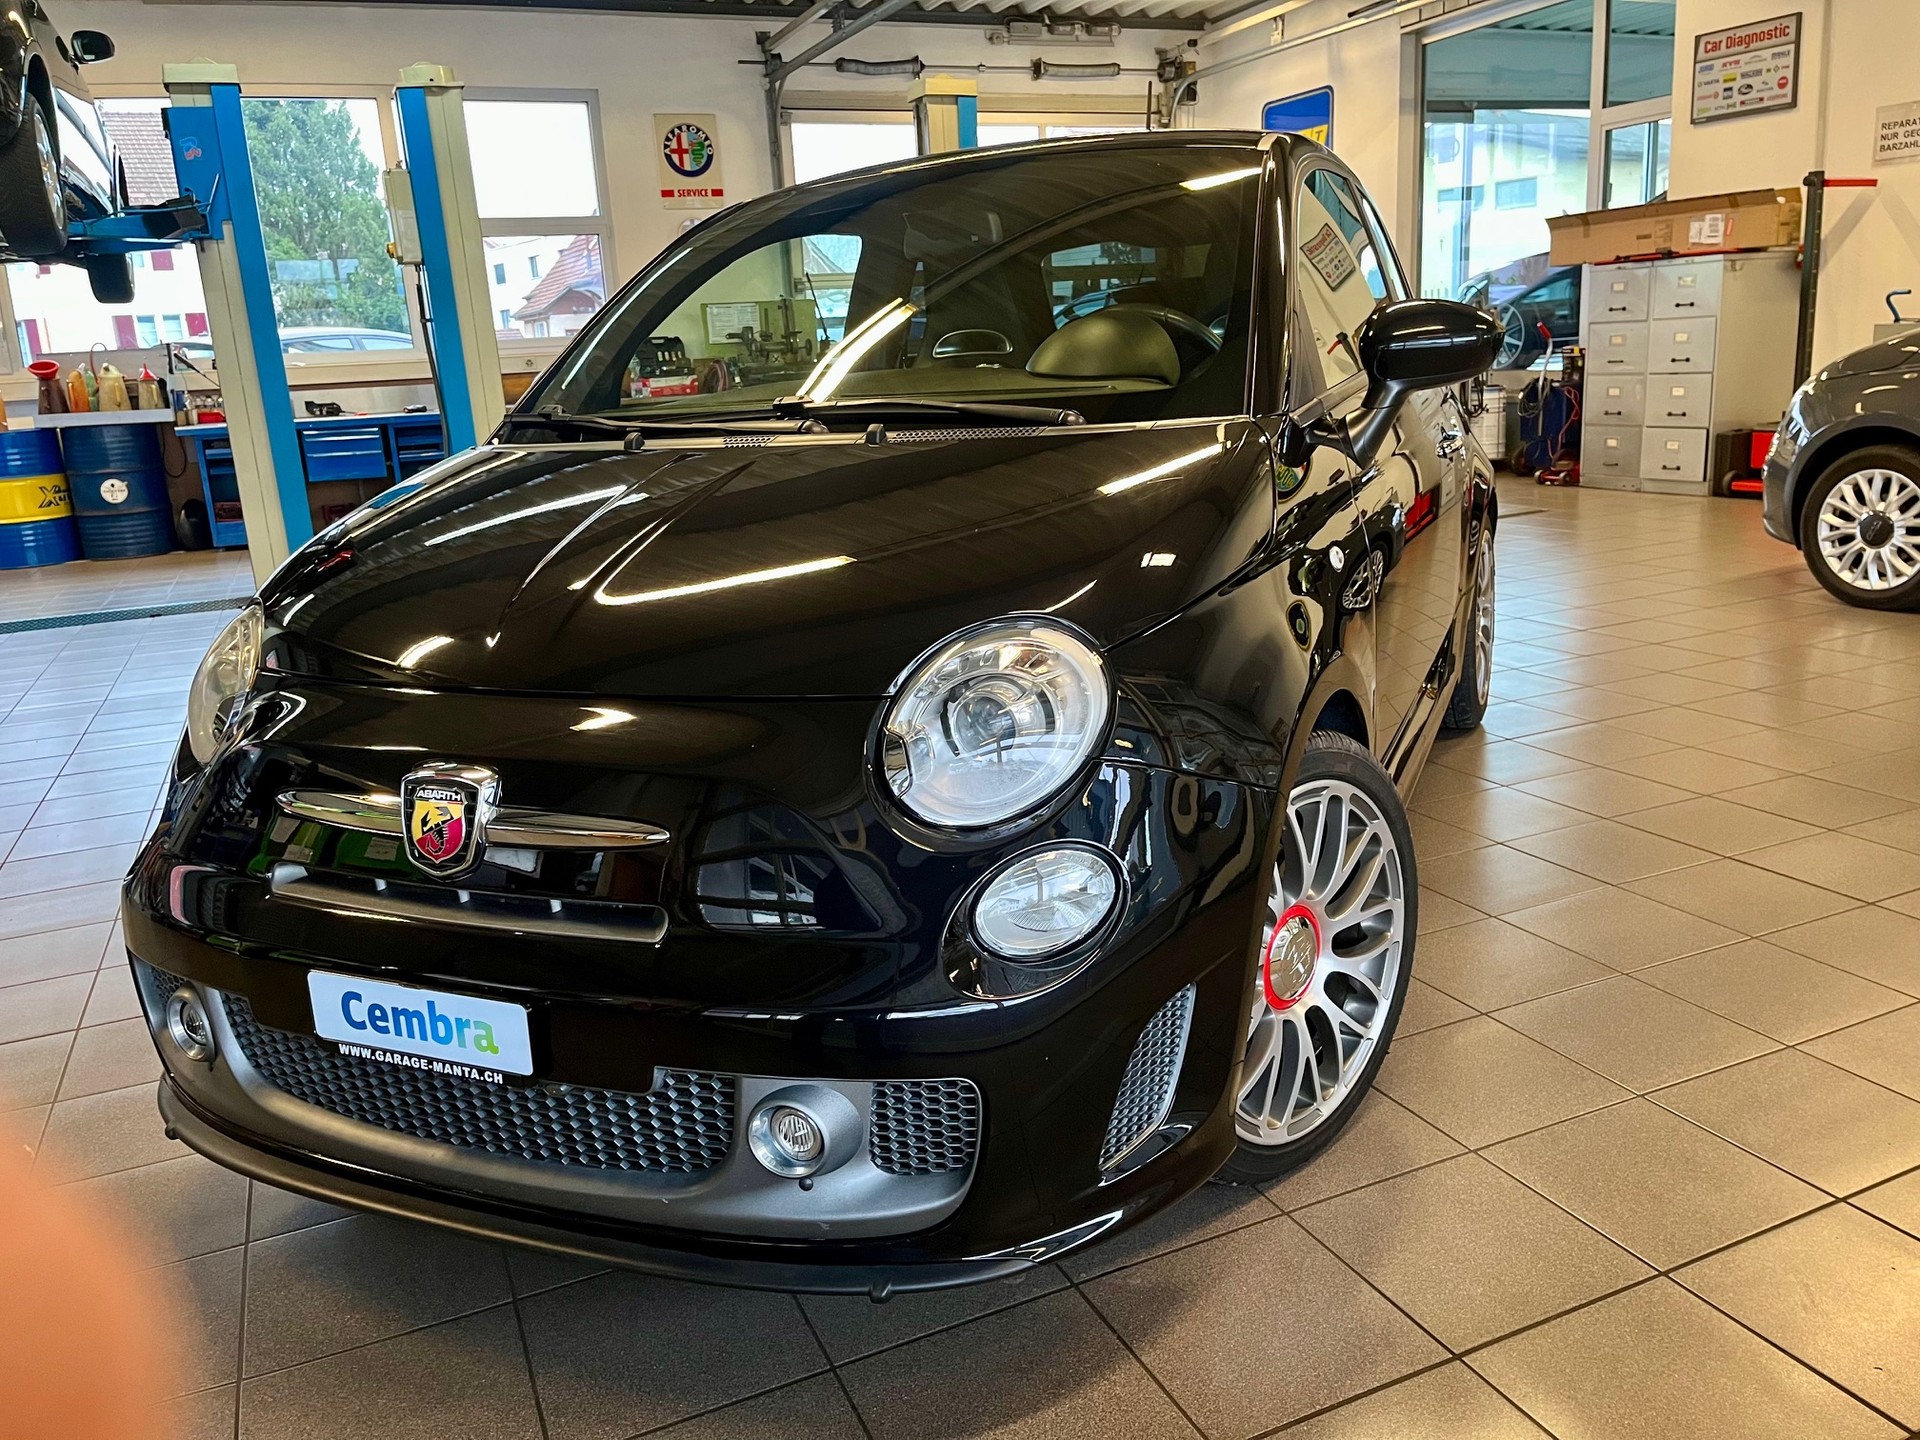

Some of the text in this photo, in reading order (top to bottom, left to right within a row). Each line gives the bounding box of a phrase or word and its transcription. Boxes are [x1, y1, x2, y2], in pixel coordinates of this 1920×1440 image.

[1704, 23, 1791, 54] Car Diagnostic
[1880, 131, 1899, 142] NUR
[1879, 140, 1920, 153] BARZAHL
[677, 188, 709, 197] SERVICE
[416, 789, 461, 801] ABARTH
[341, 990, 500, 1055] Cembra
[338, 1043, 504, 1084] WWW.GARAGE-MANTA.CH
